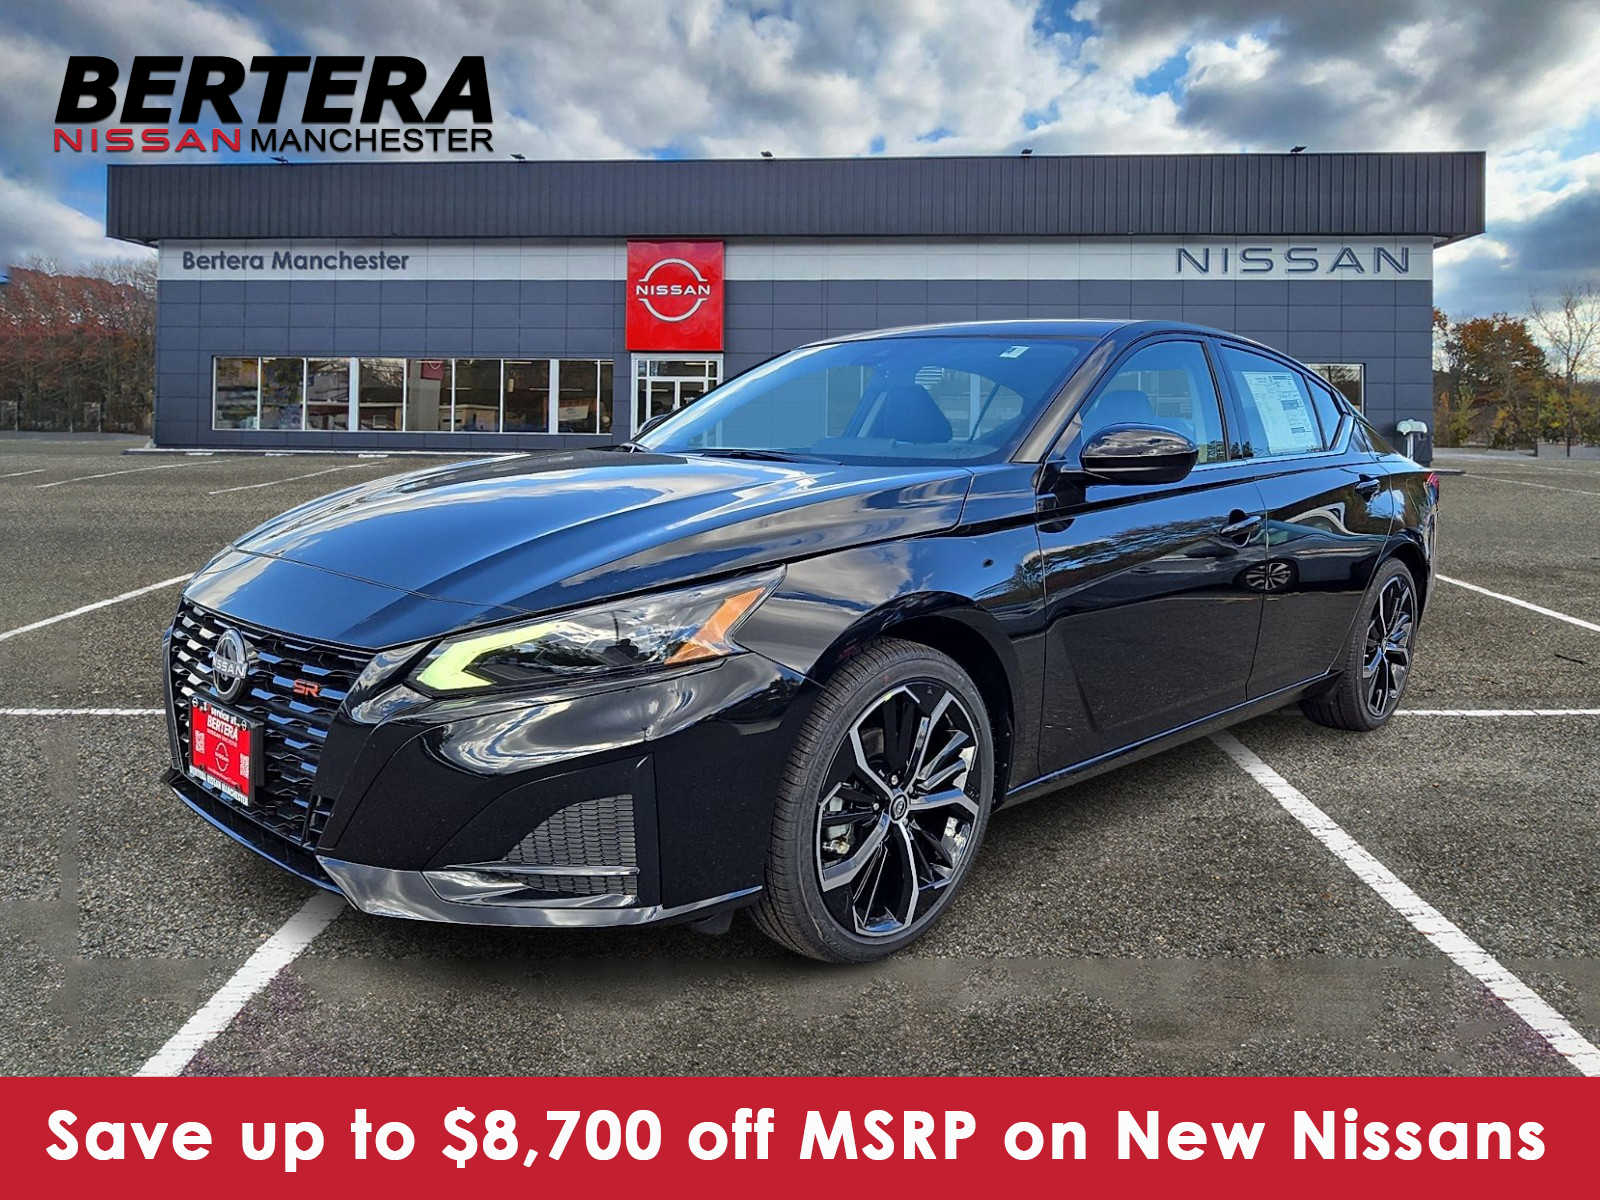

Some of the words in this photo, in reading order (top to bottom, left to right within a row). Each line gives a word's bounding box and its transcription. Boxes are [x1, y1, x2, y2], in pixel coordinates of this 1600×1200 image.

[182, 250, 264, 270] Bertera
[271, 250, 409, 270] Manchester
[1176, 247, 1410, 273] NISSAN
[635, 284, 711, 296] NISSAN
[213, 657, 248, 678] SSAN
[293, 679, 320, 698] SR
[207, 714, 239, 742] BERTERA
